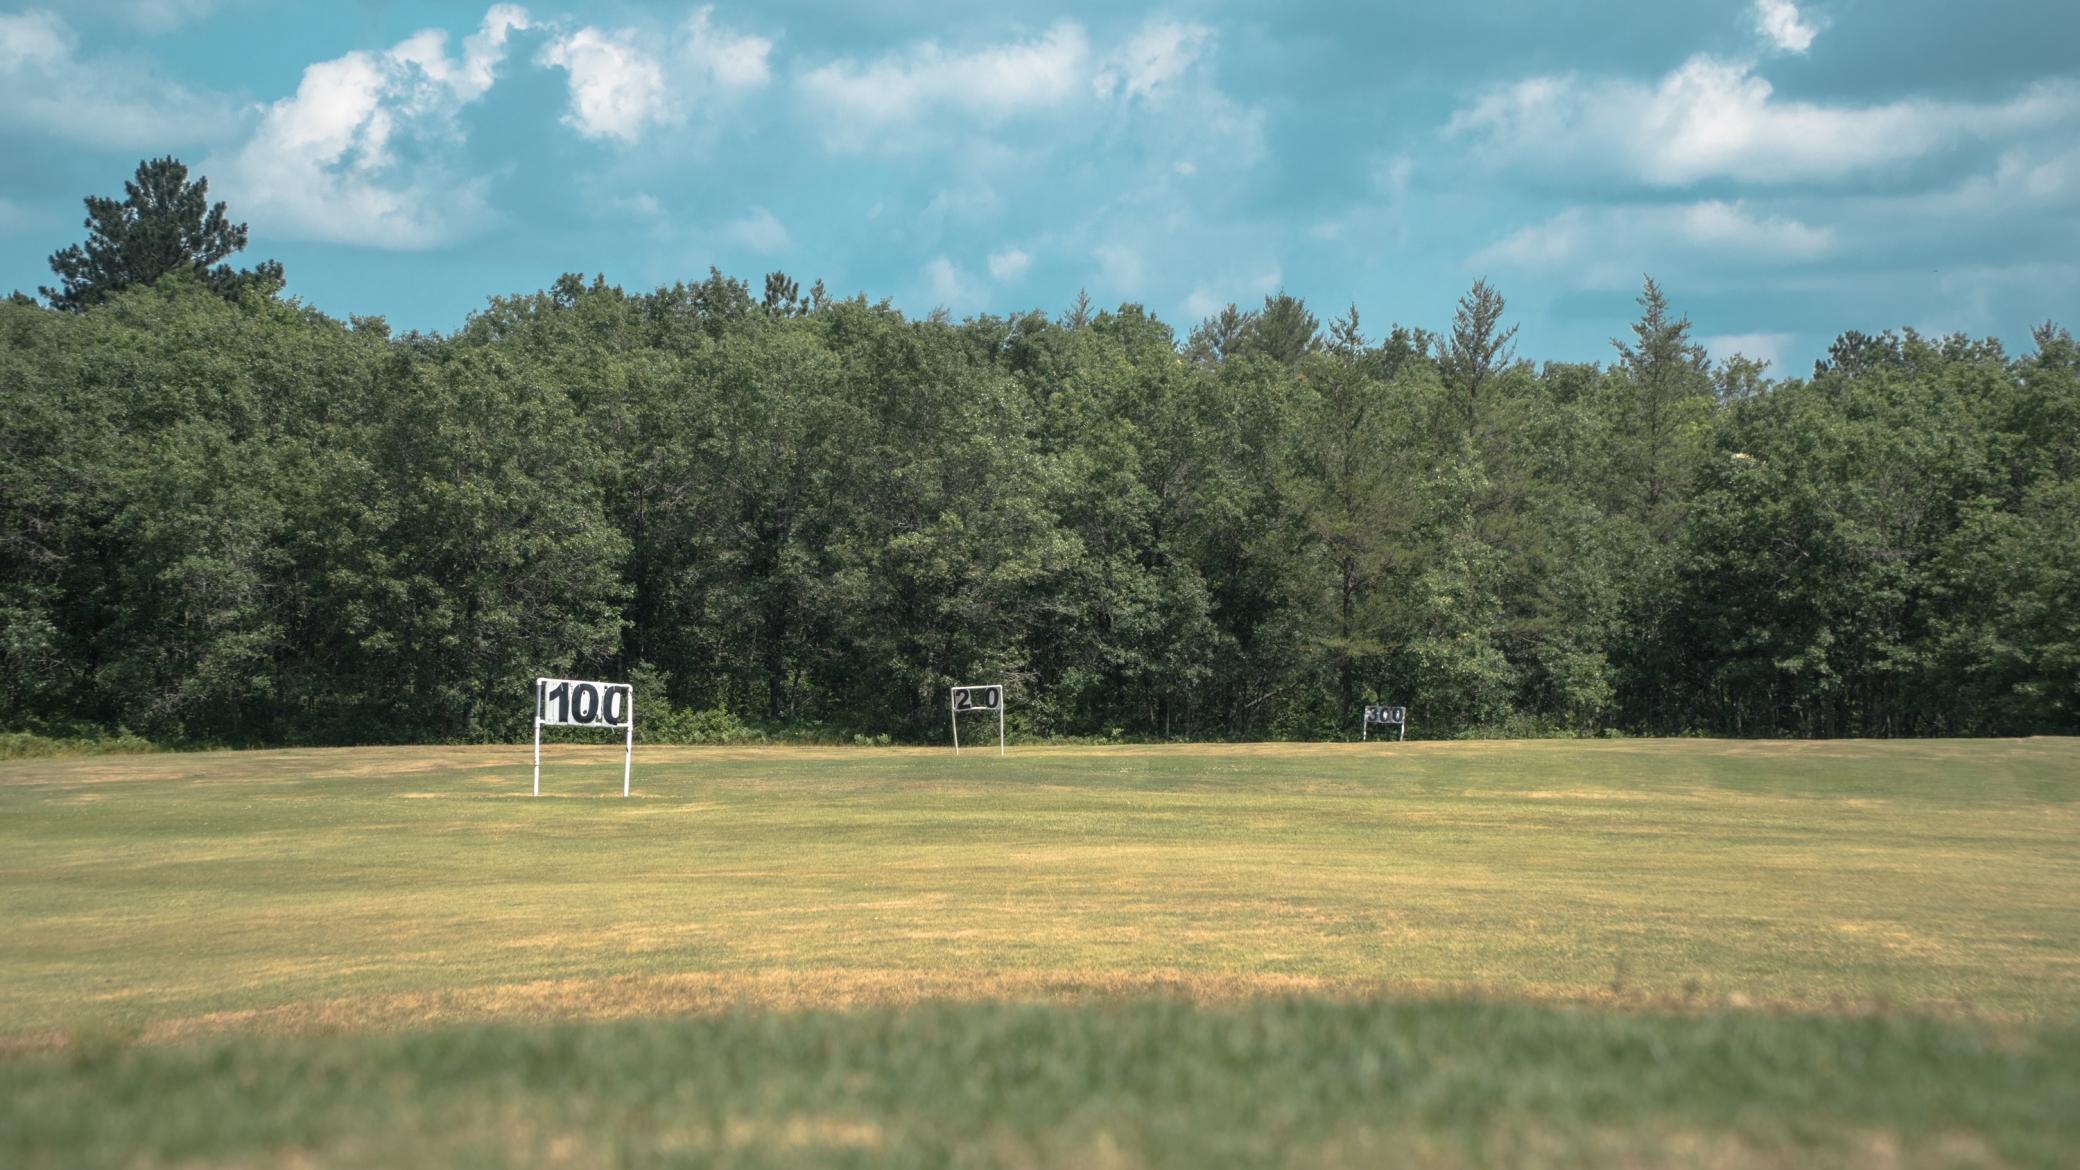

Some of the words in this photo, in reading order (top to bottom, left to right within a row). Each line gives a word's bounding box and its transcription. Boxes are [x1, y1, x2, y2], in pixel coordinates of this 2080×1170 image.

[549, 682, 622, 725] 100
[955, 687, 999, 709] 20
[1367, 707, 1403, 722] 300
